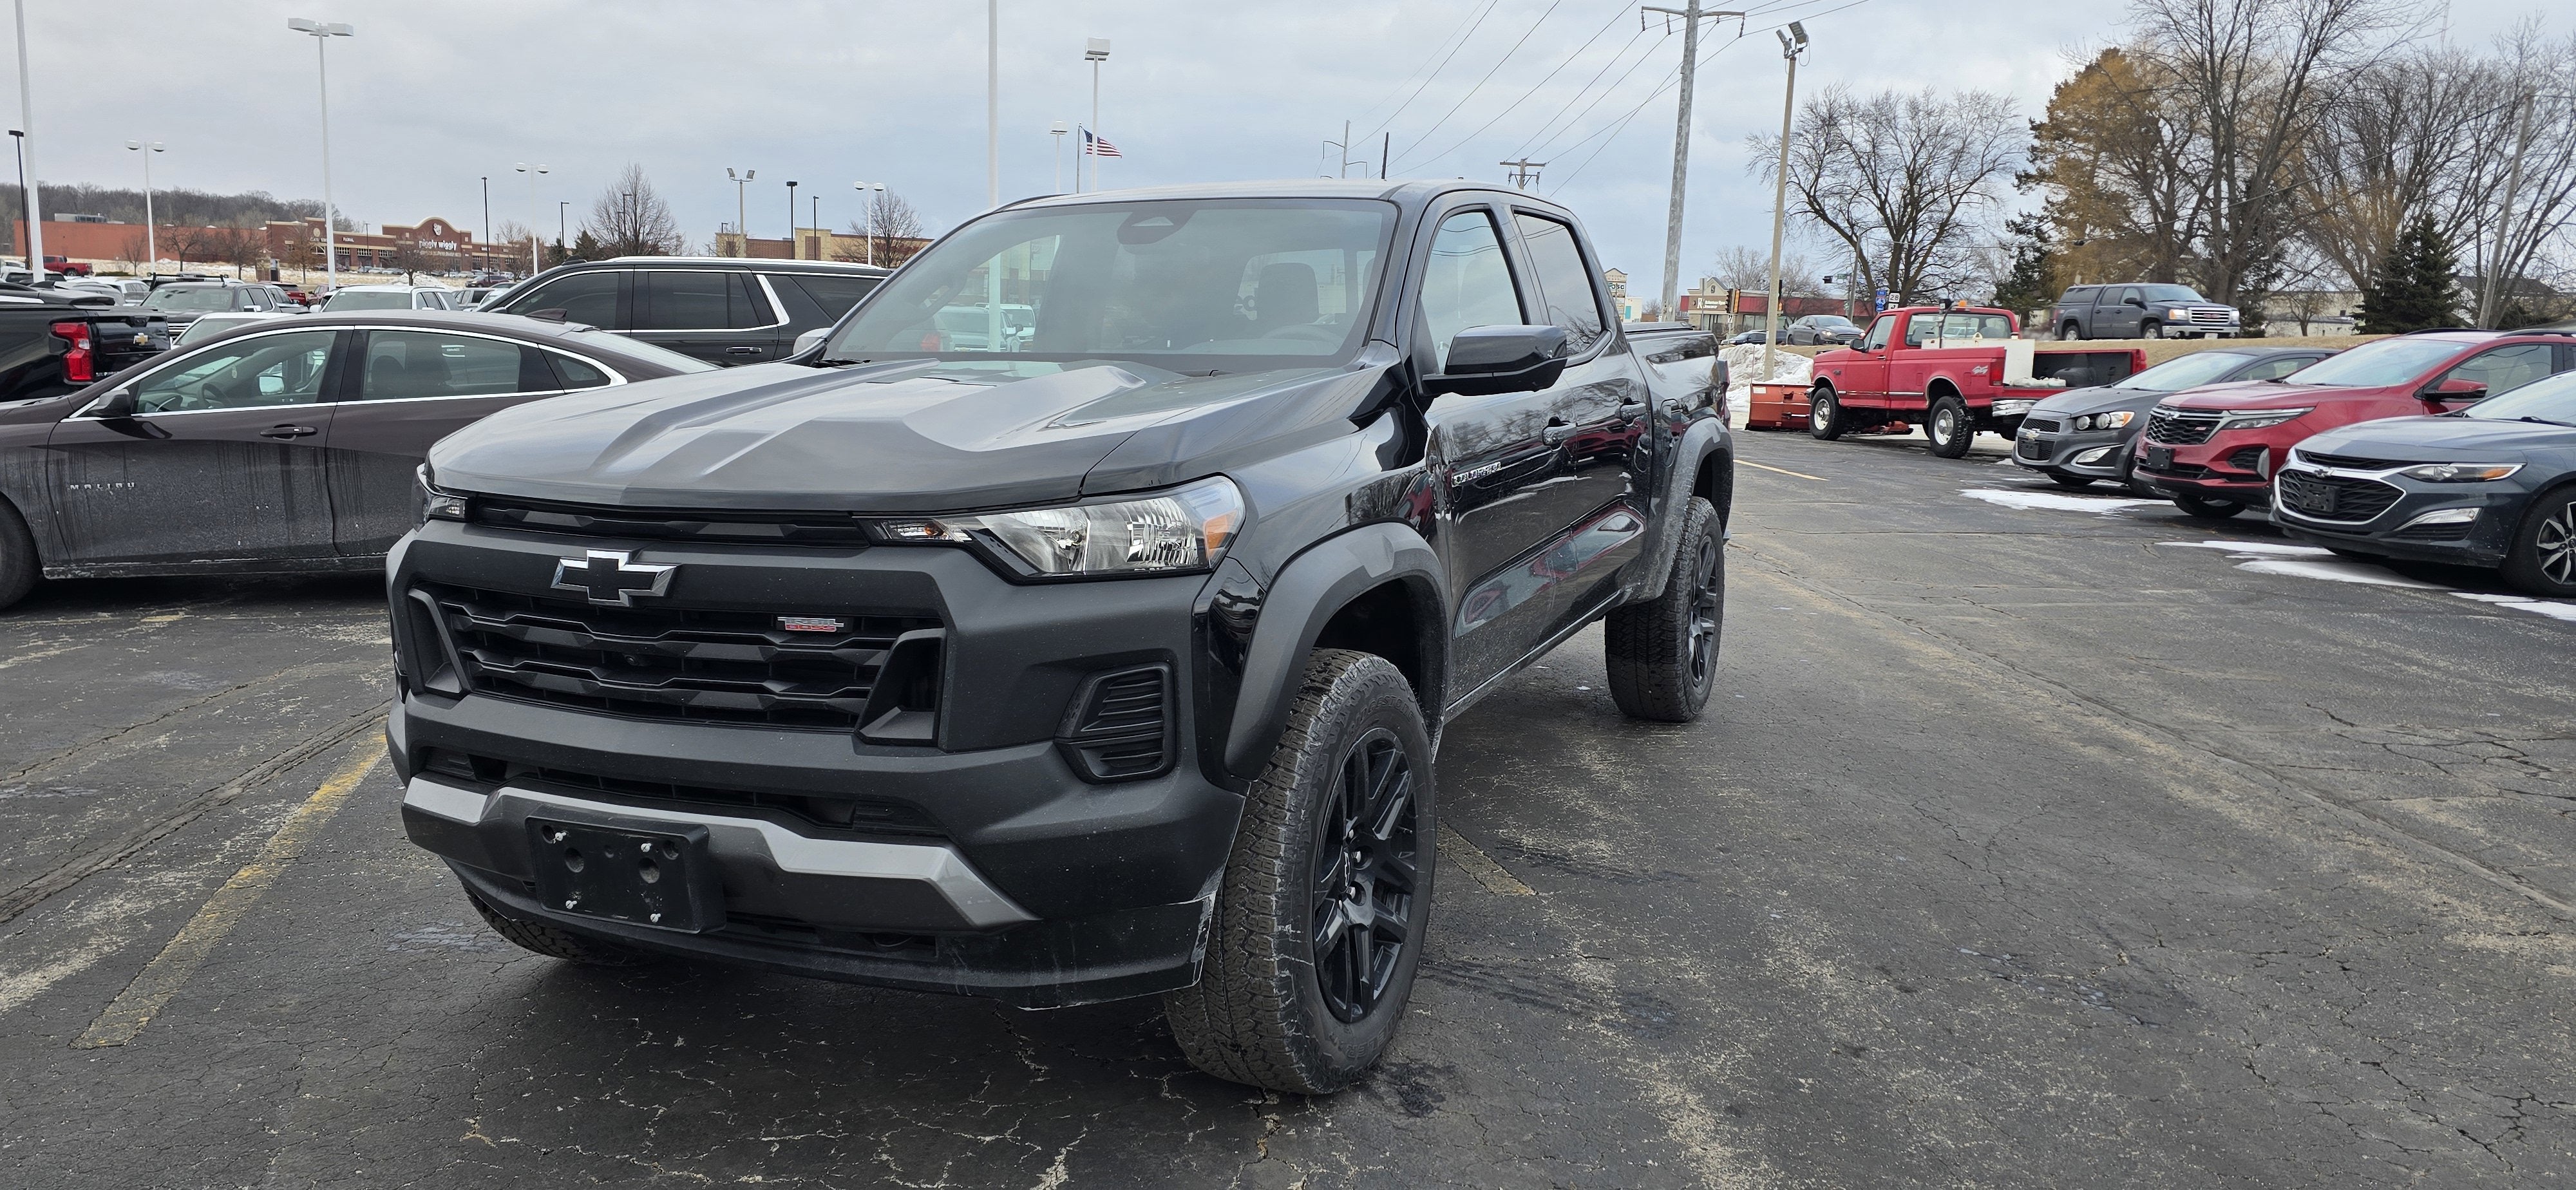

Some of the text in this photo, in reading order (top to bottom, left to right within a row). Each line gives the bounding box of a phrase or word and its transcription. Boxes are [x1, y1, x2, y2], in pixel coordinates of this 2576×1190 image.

[419, 239, 457, 251] piggly wiggly
[70, 482, 135, 490] MALIBU
[777, 616, 844, 628] TRAIL
[784, 623, 837, 632] BOSS
